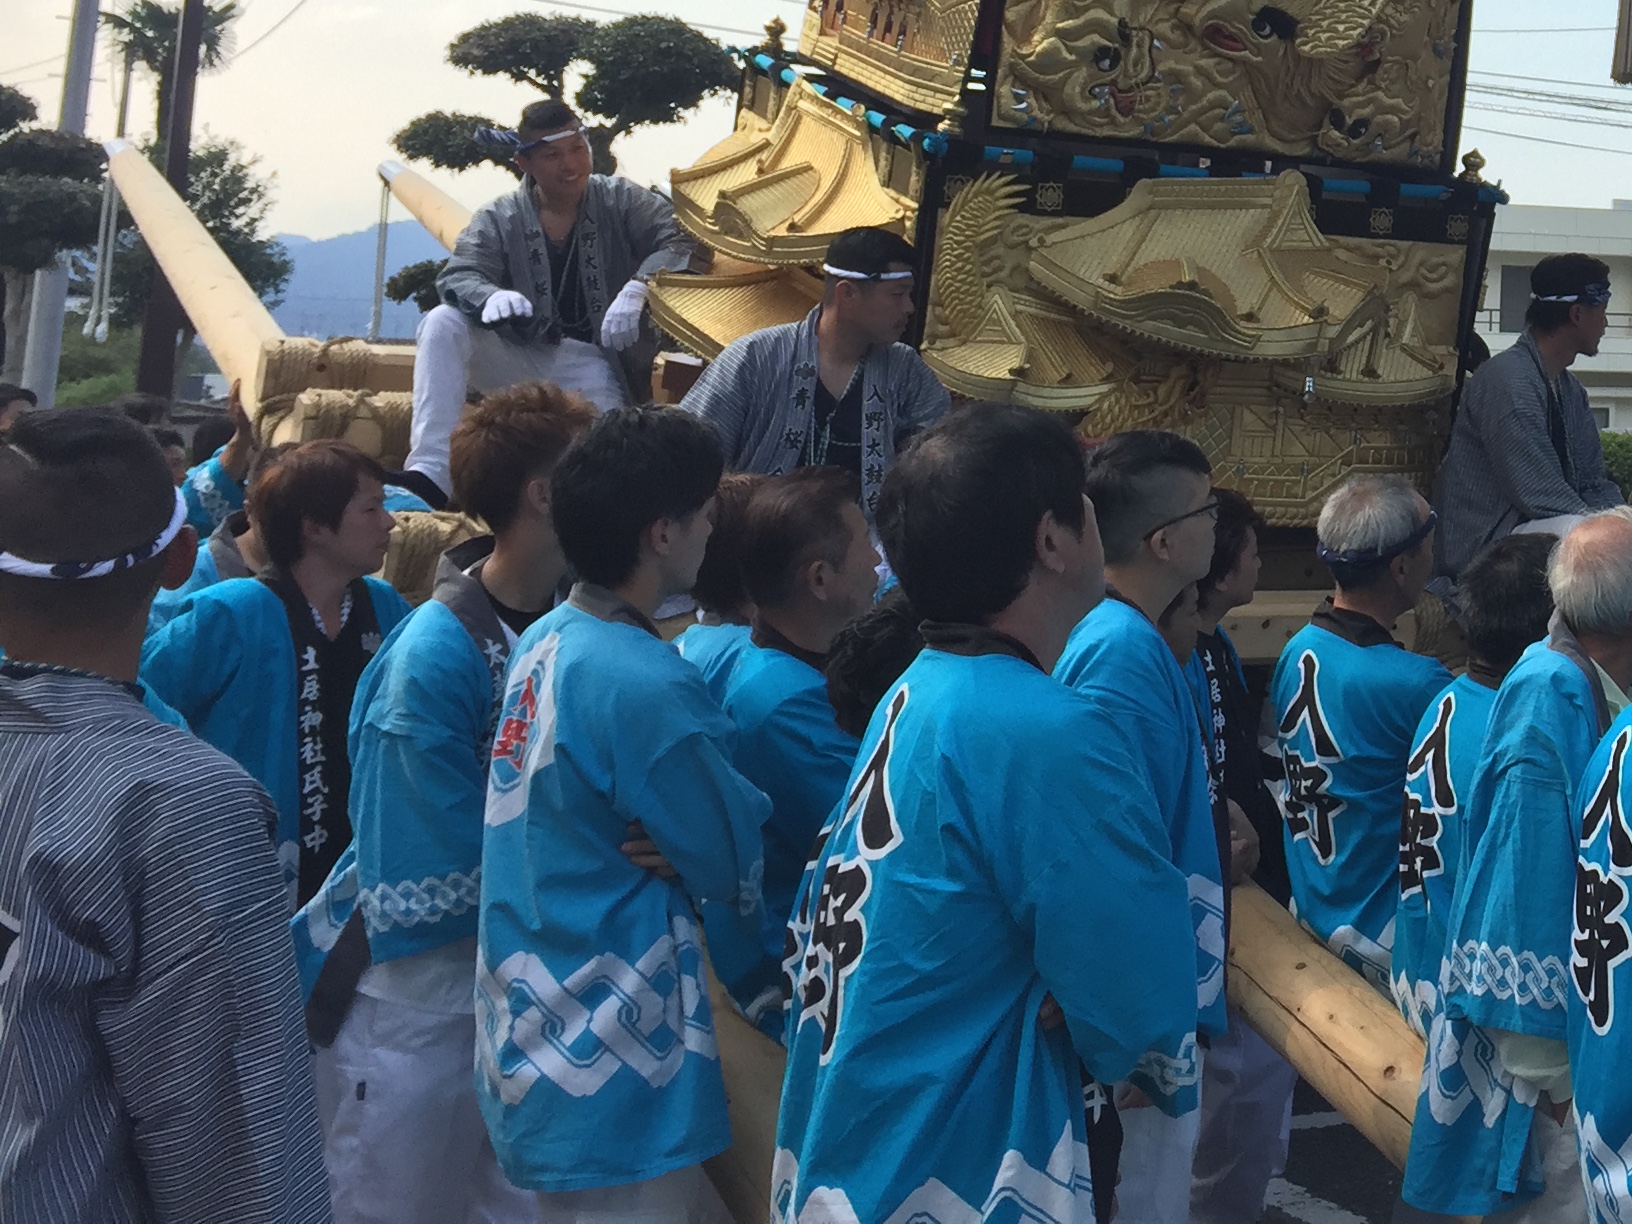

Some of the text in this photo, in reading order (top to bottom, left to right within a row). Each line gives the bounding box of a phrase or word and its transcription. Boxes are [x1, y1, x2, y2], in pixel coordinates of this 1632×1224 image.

[769, 386, 812, 477] 青桜
[864, 384, 886, 512] 入野太鼓台
[299, 645, 330, 853] 土居神社氏子中
[491, 674, 538, 773] 入野
[1203, 648, 1228, 783] 土居神社
[1279, 649, 1345, 865] 入野
[797, 681, 905, 1067] 入野
